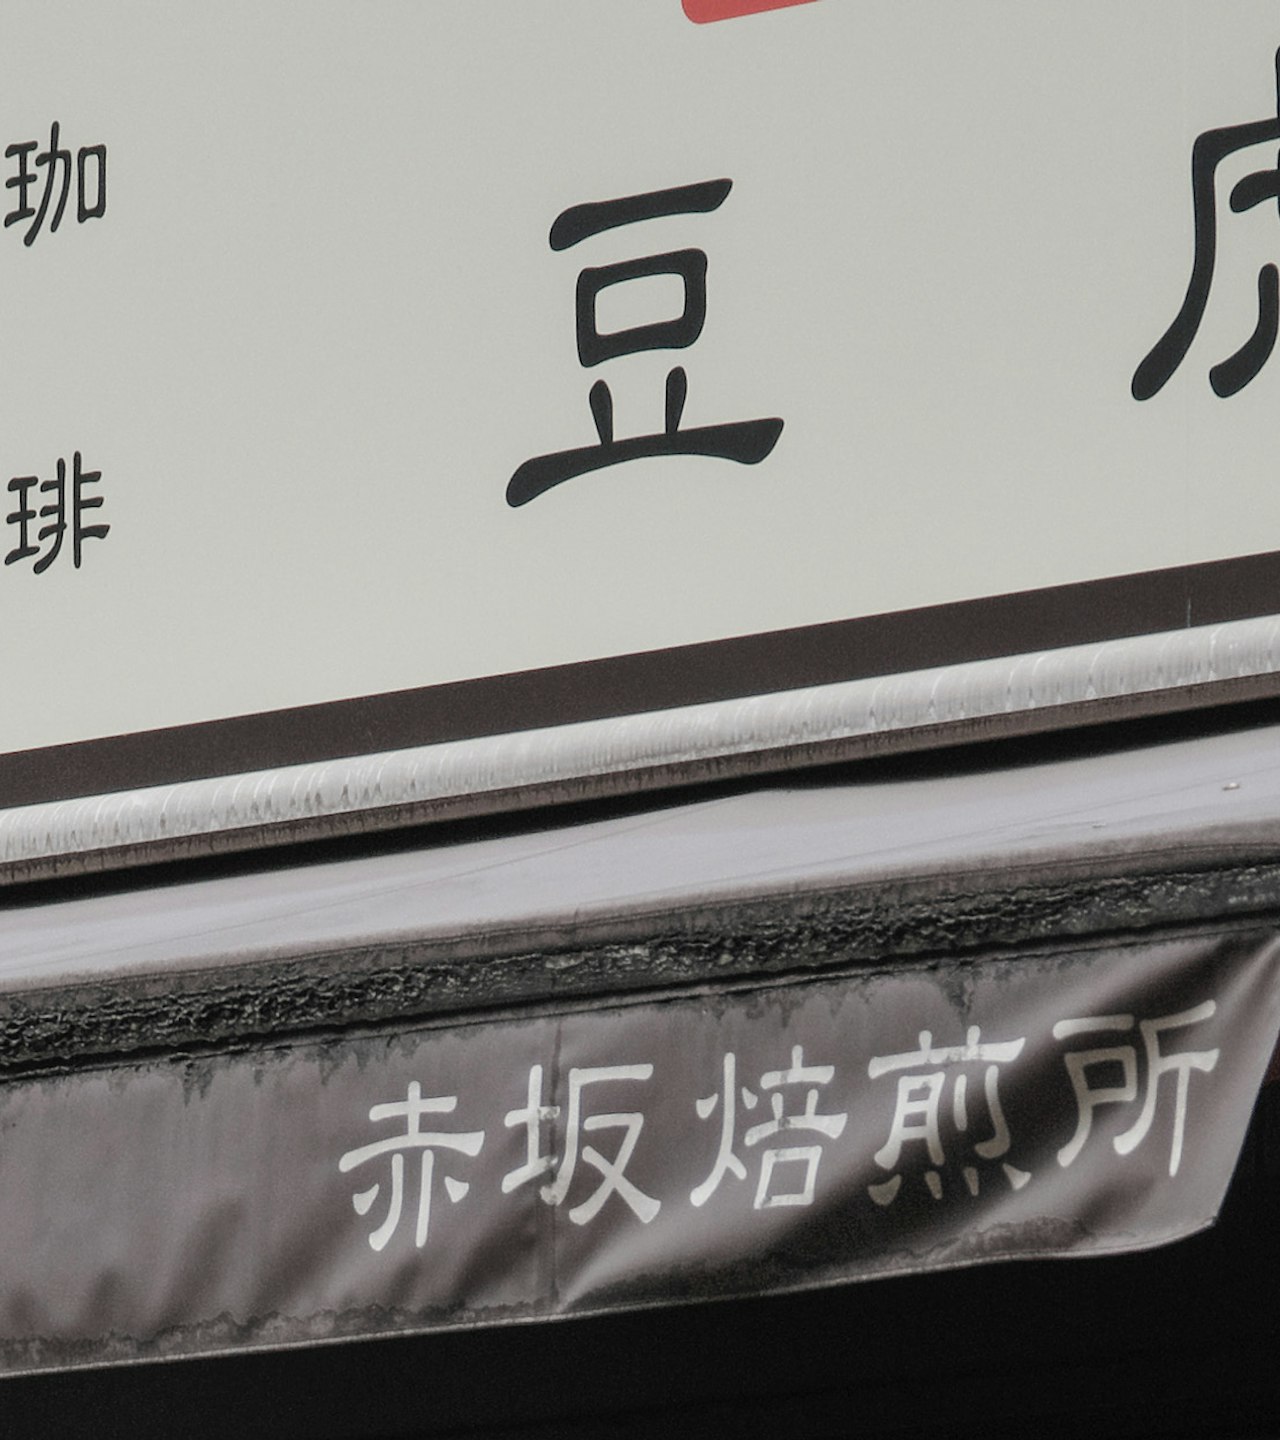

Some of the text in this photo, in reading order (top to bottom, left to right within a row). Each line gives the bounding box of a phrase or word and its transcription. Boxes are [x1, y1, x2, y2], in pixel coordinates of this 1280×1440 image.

[4, 118, 110, 577] 珈琲
[338, 998, 1220, 1251] 赤坂焙煎所
